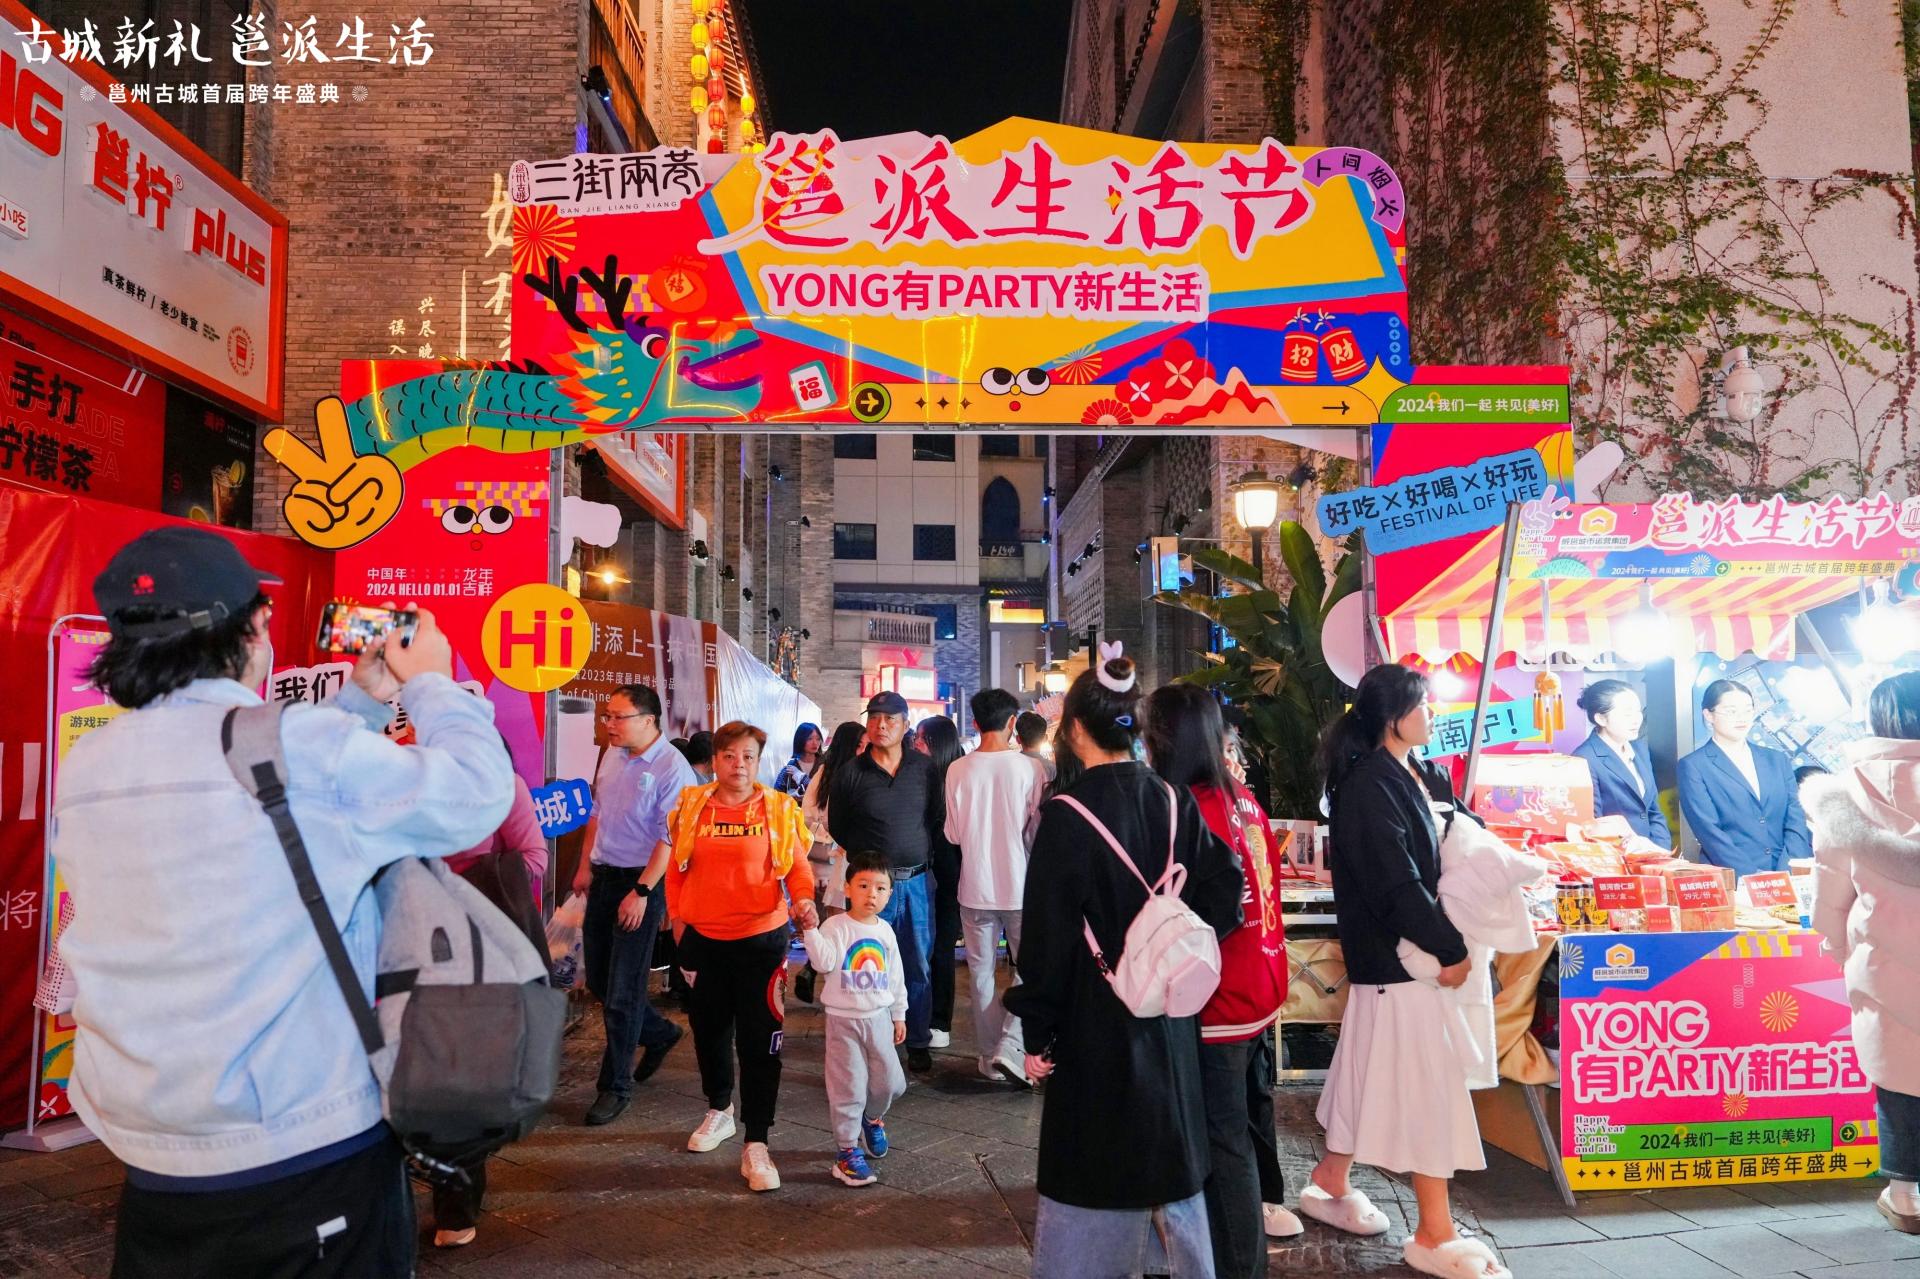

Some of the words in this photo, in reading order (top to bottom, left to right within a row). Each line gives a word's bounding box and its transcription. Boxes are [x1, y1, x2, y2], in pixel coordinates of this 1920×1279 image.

[608, 203, 639, 211] LIANG
[762, 134, 1309, 254] 邕派生活节
[0, 203, 26, 232] 小吃
[192, 207, 266, 287] plus
[768, 270, 1203, 312] YONG有PARTY新生活
[11, 361, 84, 425] 手打
[1380, 500, 1469, 533] FESTIVAL
[1474, 492, 1496, 511] OF
[1502, 483, 1541, 504] LIFE
[1651, 494, 1893, 547] 邕派生活节
[367, 567, 407, 580] 中国年
[1765, 562, 1896, 575] 邕州古城首届跨年盛典
[367, 583, 396, 596] 2024
[398, 583, 431, 596] HELLO
[433, 583, 460, 596] 01.01
[499, 606, 575, 669] Hi
[69, 715, 115, 729] 游戏玩
[1575, 1006, 1704, 1045] YONG
[1575, 1115, 1608, 1125] Happy
[1600, 1125, 1625, 1133] Year
[1575, 1145, 1594, 1153] and
[1623, 1153, 1848, 1183] 邕州古城首届跨年盛典
